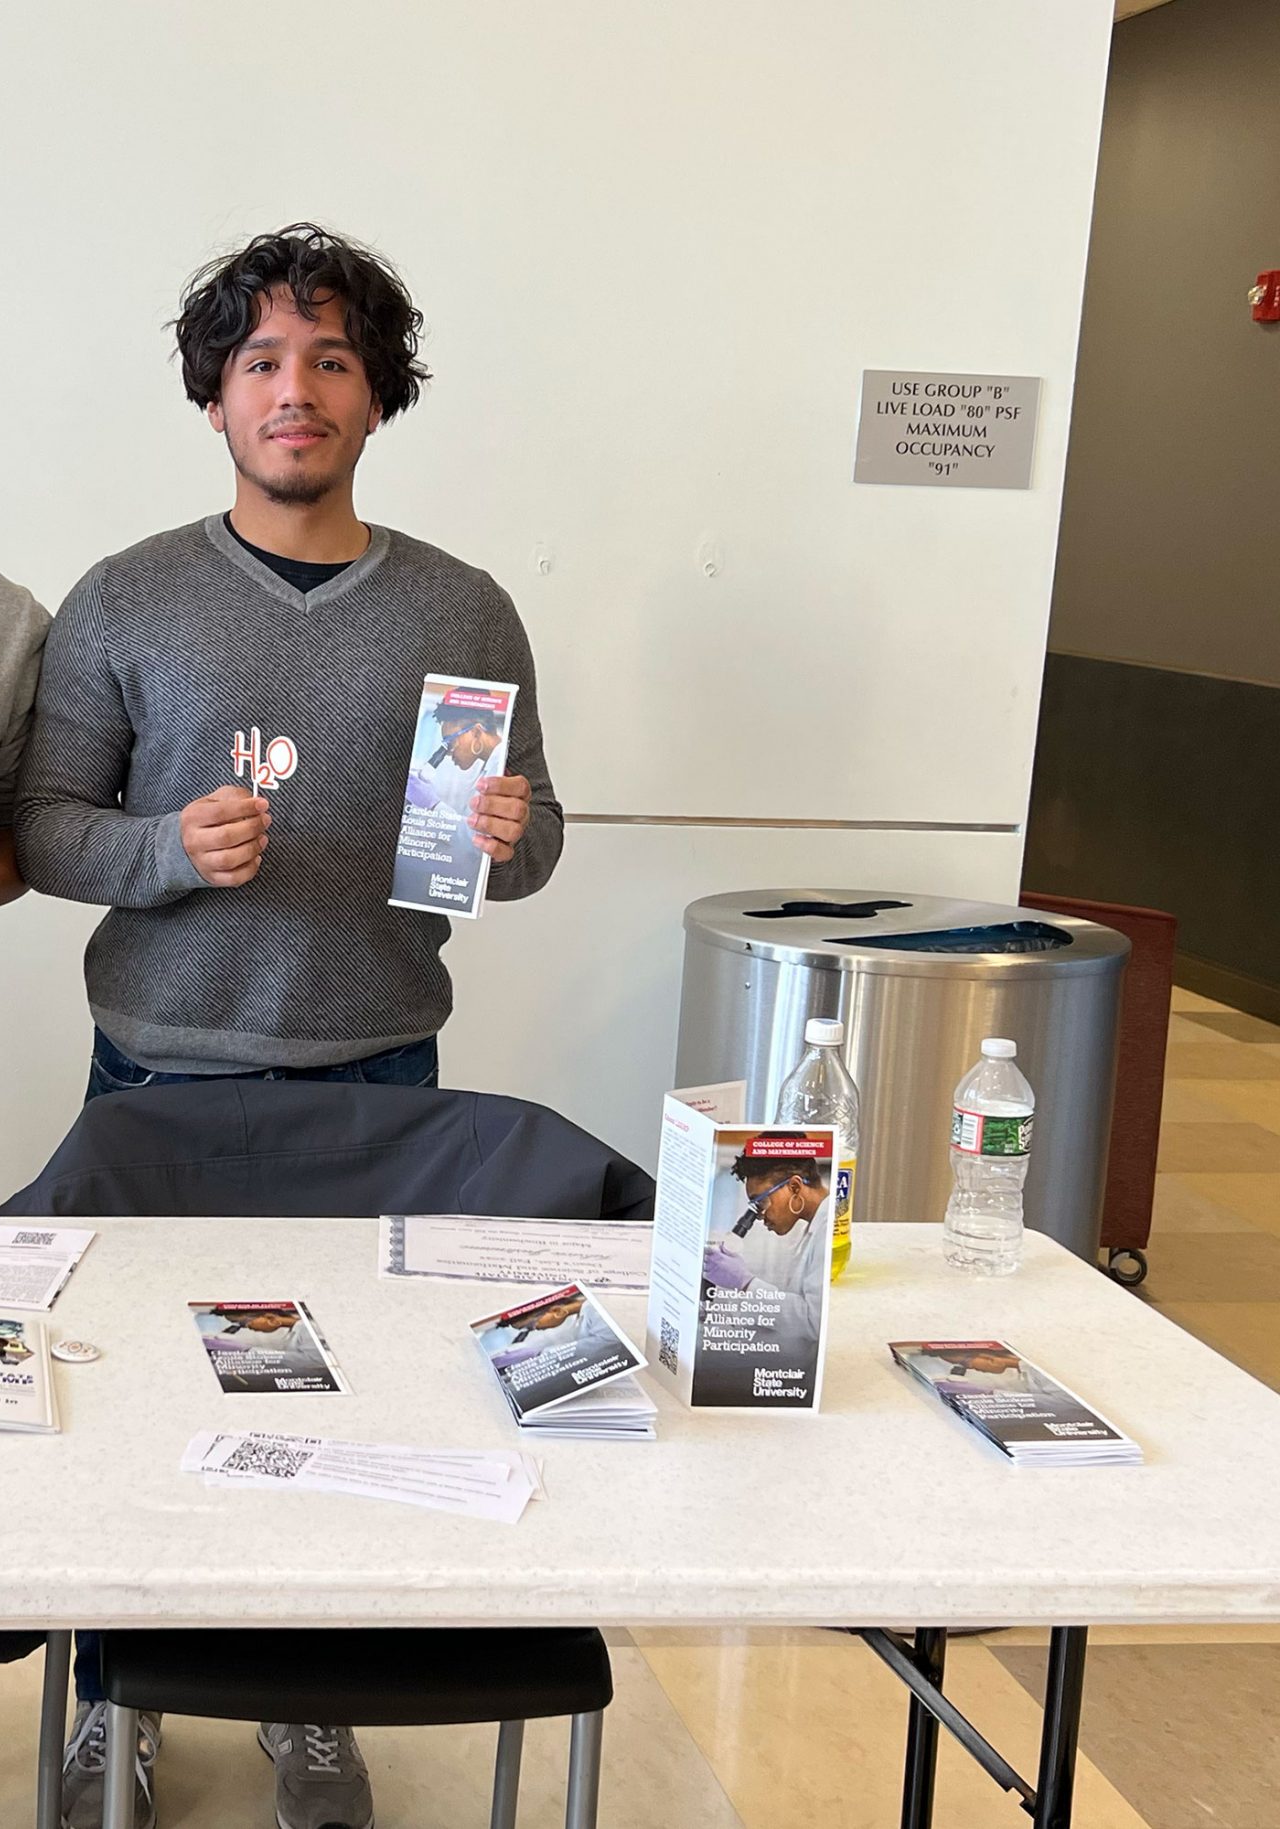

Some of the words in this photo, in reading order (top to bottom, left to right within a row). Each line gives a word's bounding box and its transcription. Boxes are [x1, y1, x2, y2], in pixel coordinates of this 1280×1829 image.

[892, 382, 920, 396] USE
[925, 383, 982, 398] GROUP
[987, 386, 1010, 400] "B"
[877, 401, 908, 415] LIVE
[912, 403, 956, 417] LOAD
[961, 406, 991, 418] "80"
[995, 407, 1022, 420] PSF
[906, 423, 987, 438] MAXIMUM
[895, 442, 995, 458] OCCUPANCY
[928, 462, 959, 476] "91"
[404, 804, 439, 817] Garden
[439, 809, 463, 822] State
[402, 815, 425, 826] Louis
[427, 818, 457, 831] Stokes
[400, 826, 437, 840] Alliance
[438, 831, 452, 842] for
[398, 835, 437, 850] Minority
[397, 846, 453, 863] Participation
[431, 874, 469, 887] Montclair
[431, 882, 451, 892] State
[428, 889, 469, 904] University
[706, 1287, 754, 1300] Garden
[756, 1288, 786, 1301] State
[705, 1301, 738, 1312] Louis
[740, 1301, 781, 1313] Stokes
[704, 1314, 755, 1326] Alliance
[757, 1315, 776, 1327] for
[703, 1326, 756, 1341] Minority
[702, 1339, 780, 1354] Participation
[754, 1368, 806, 1379] Montclair
[754, 1377, 783, 1388] State
[753, 1386, 808, 1399] University
[978, 1412, 1056, 1420] Participation
